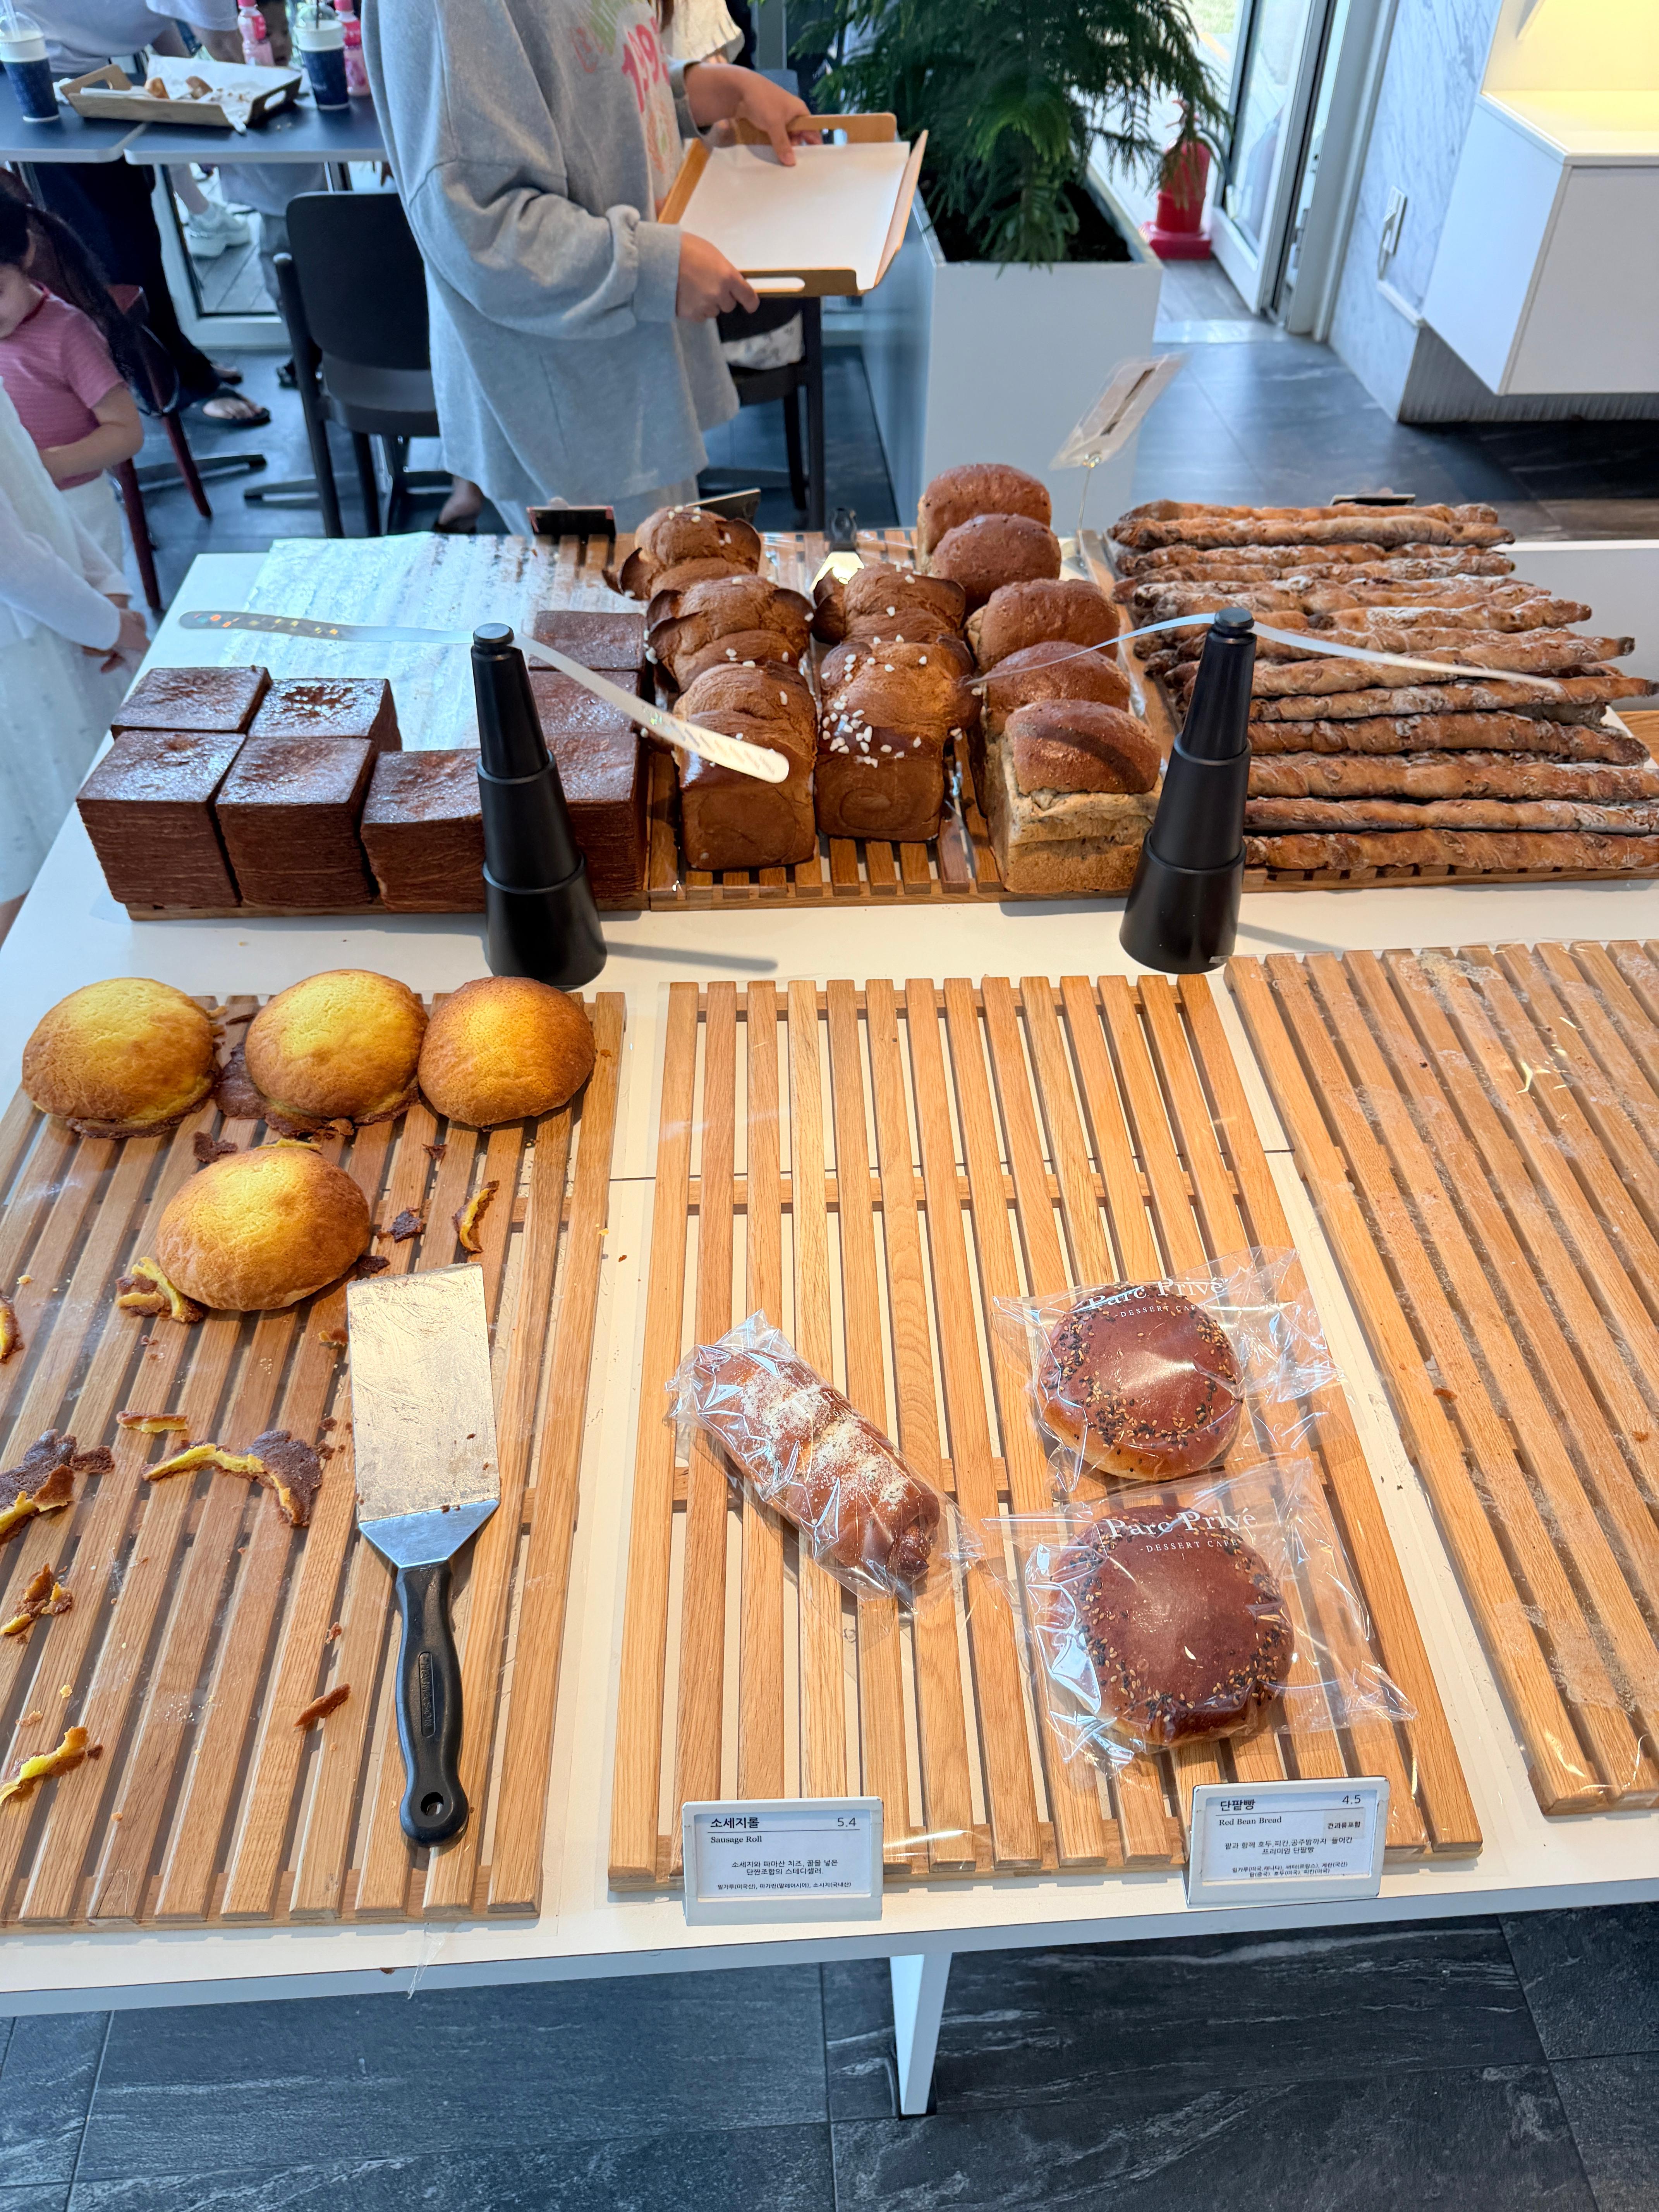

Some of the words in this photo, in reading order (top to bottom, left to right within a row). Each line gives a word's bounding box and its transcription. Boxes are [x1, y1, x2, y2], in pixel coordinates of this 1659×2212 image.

[1087, 1286, 1147, 1309] Parc
[1157, 1276, 1228, 1297] Privé
[1102, 1518, 1173, 1539] Parc
[1176, 1508, 1258, 1531] Privé
[1146, 1541, 1200, 1553] DESSERT
[1220, 1798, 1256, 1811] 단팥빵
[1342, 1794, 1361, 1805] 4.5
[710, 1817, 760, 1829] 소세지롤
[837, 1817, 857, 1827] 5.4
